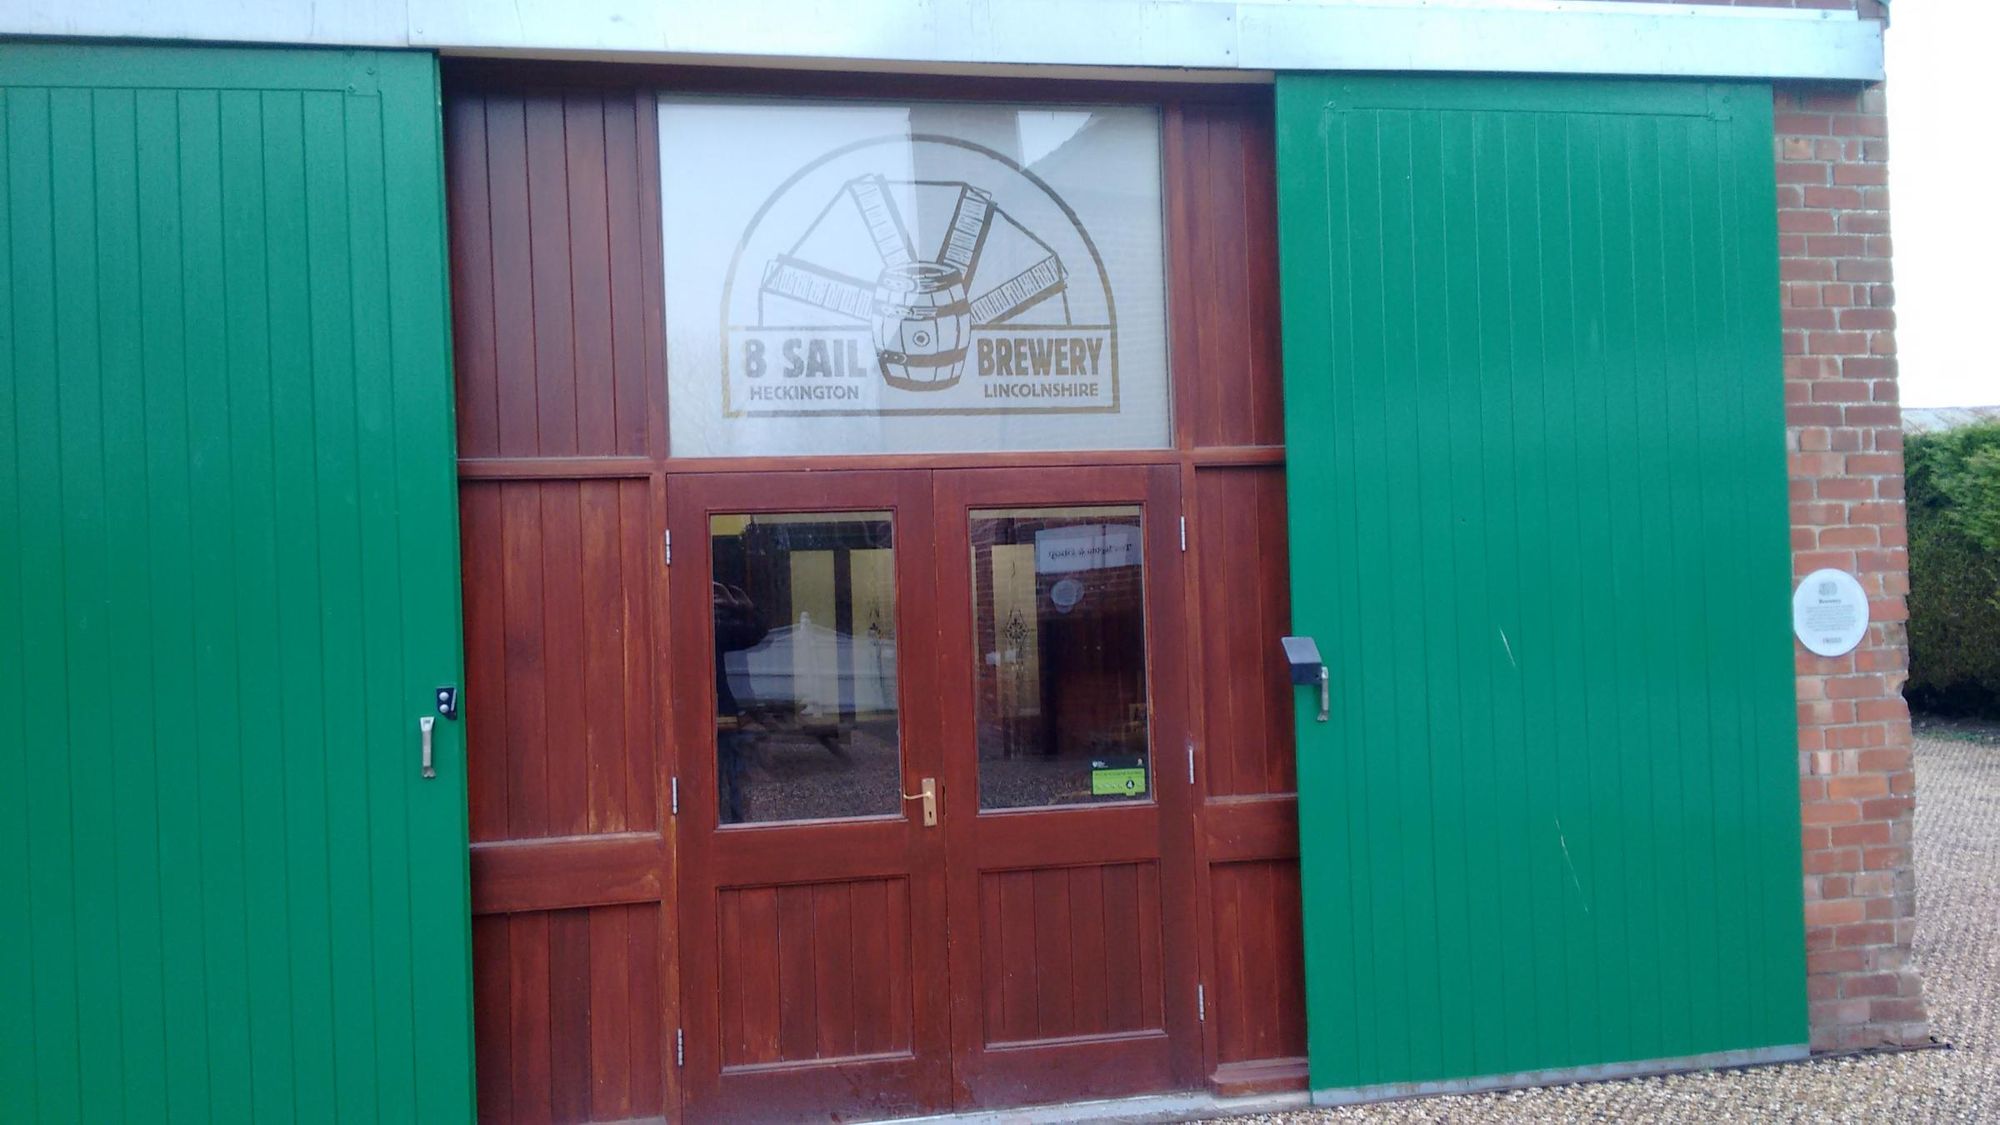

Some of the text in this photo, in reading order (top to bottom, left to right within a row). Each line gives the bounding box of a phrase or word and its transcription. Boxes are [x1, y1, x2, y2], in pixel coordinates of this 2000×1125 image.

[782, 338, 867, 378] SAIL
[977, 337, 1103, 376] BREWERY
[750, 382, 1099, 401] HECKINGTON LINCOLNSHIRE
